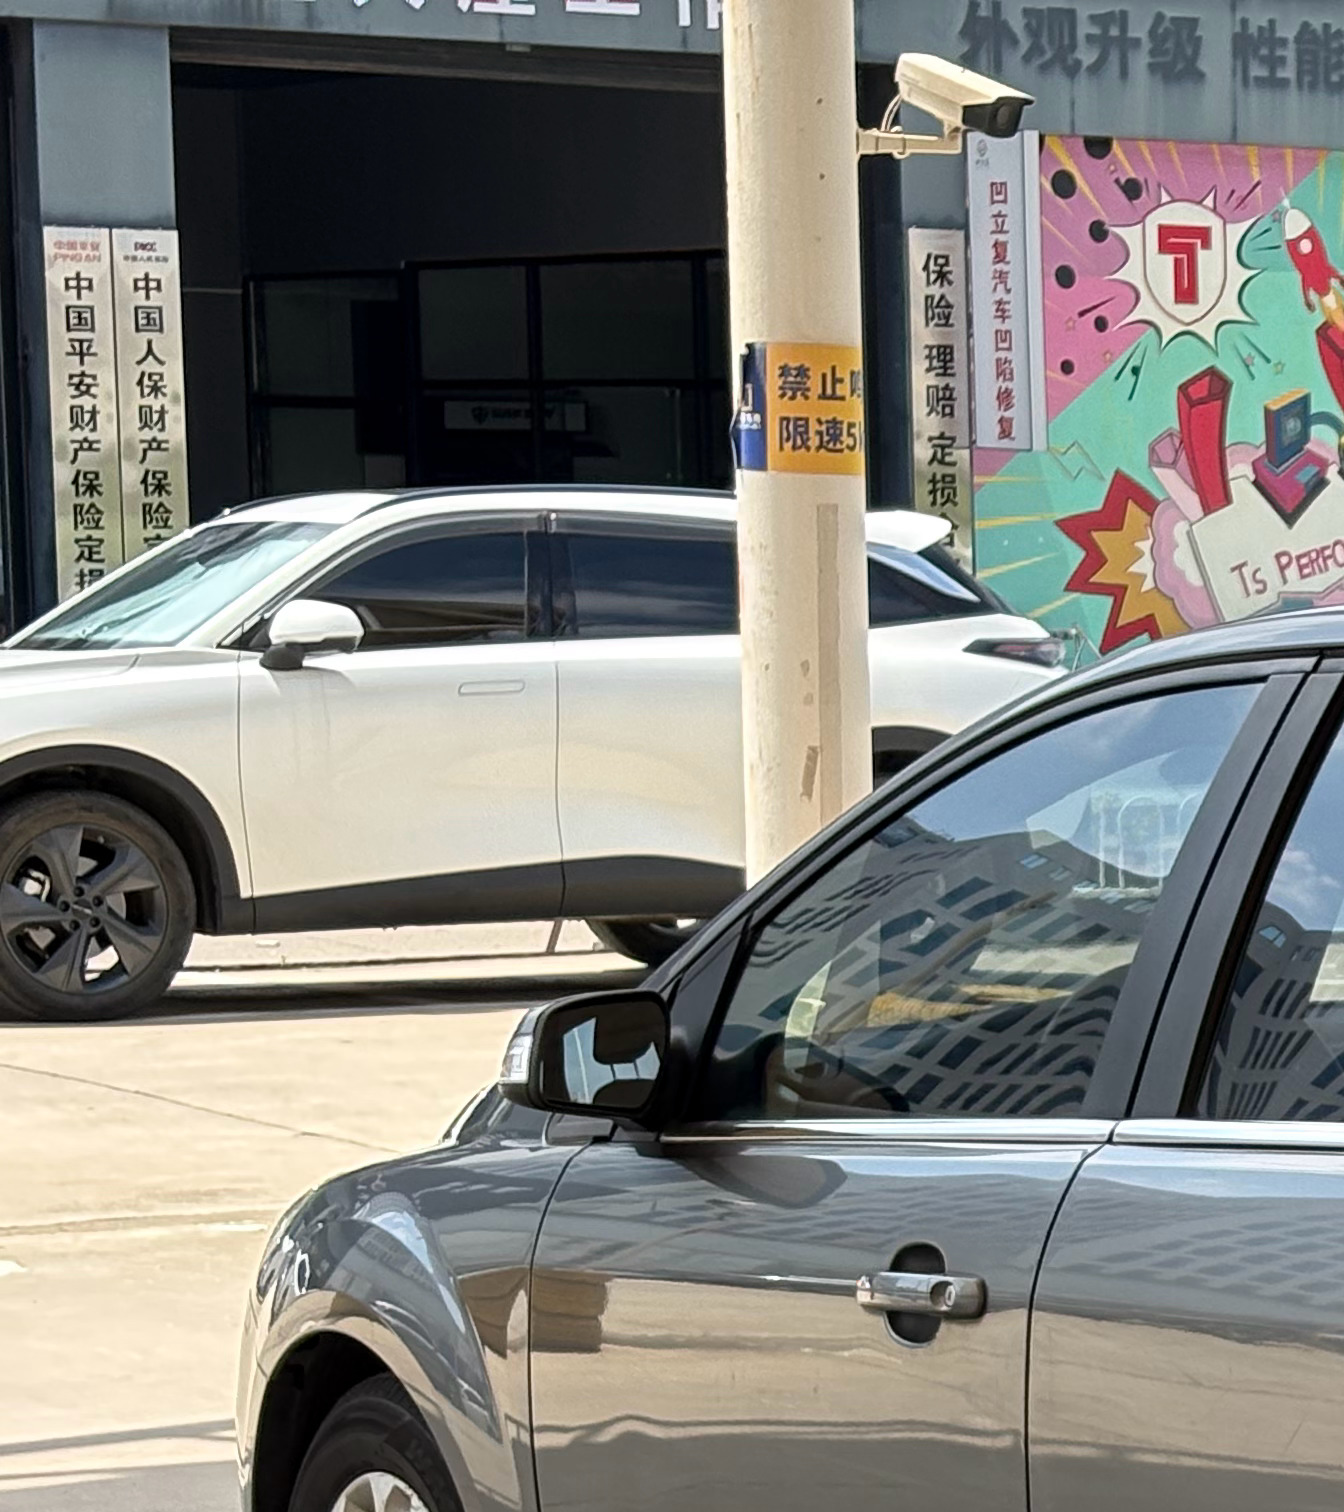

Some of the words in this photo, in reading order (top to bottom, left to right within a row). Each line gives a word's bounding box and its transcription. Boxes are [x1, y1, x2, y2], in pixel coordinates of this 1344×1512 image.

[958, 0, 1206, 82] 外观升级
[778, 415, 862, 454] 限速5
